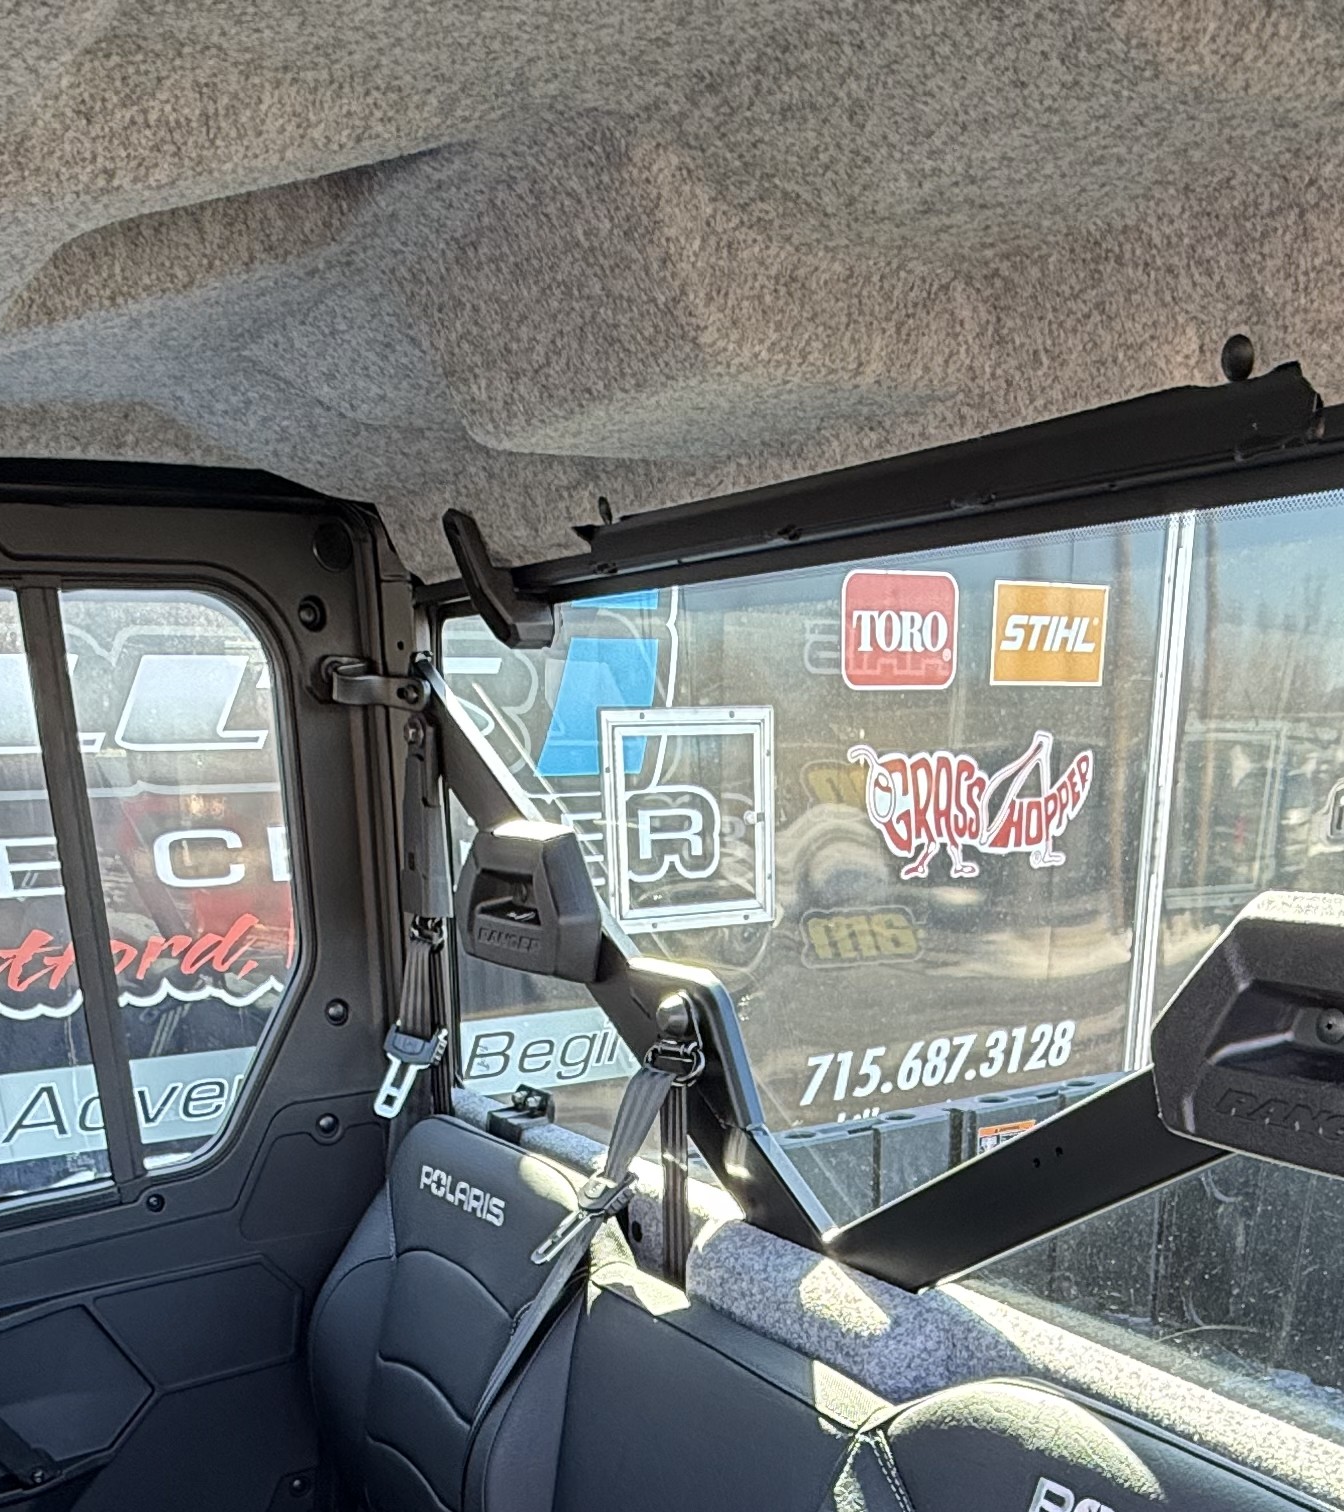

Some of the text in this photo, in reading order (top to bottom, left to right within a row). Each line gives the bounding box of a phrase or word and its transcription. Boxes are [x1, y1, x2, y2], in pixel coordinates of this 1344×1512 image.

[852, 611, 948, 652] TORO
[1000, 615, 1097, 653] STIHL
[153, 828, 293, 890] C
[800, 1020, 1076, 1107] 715.687.3128
[420, 1165, 506, 1227] POLARIS
